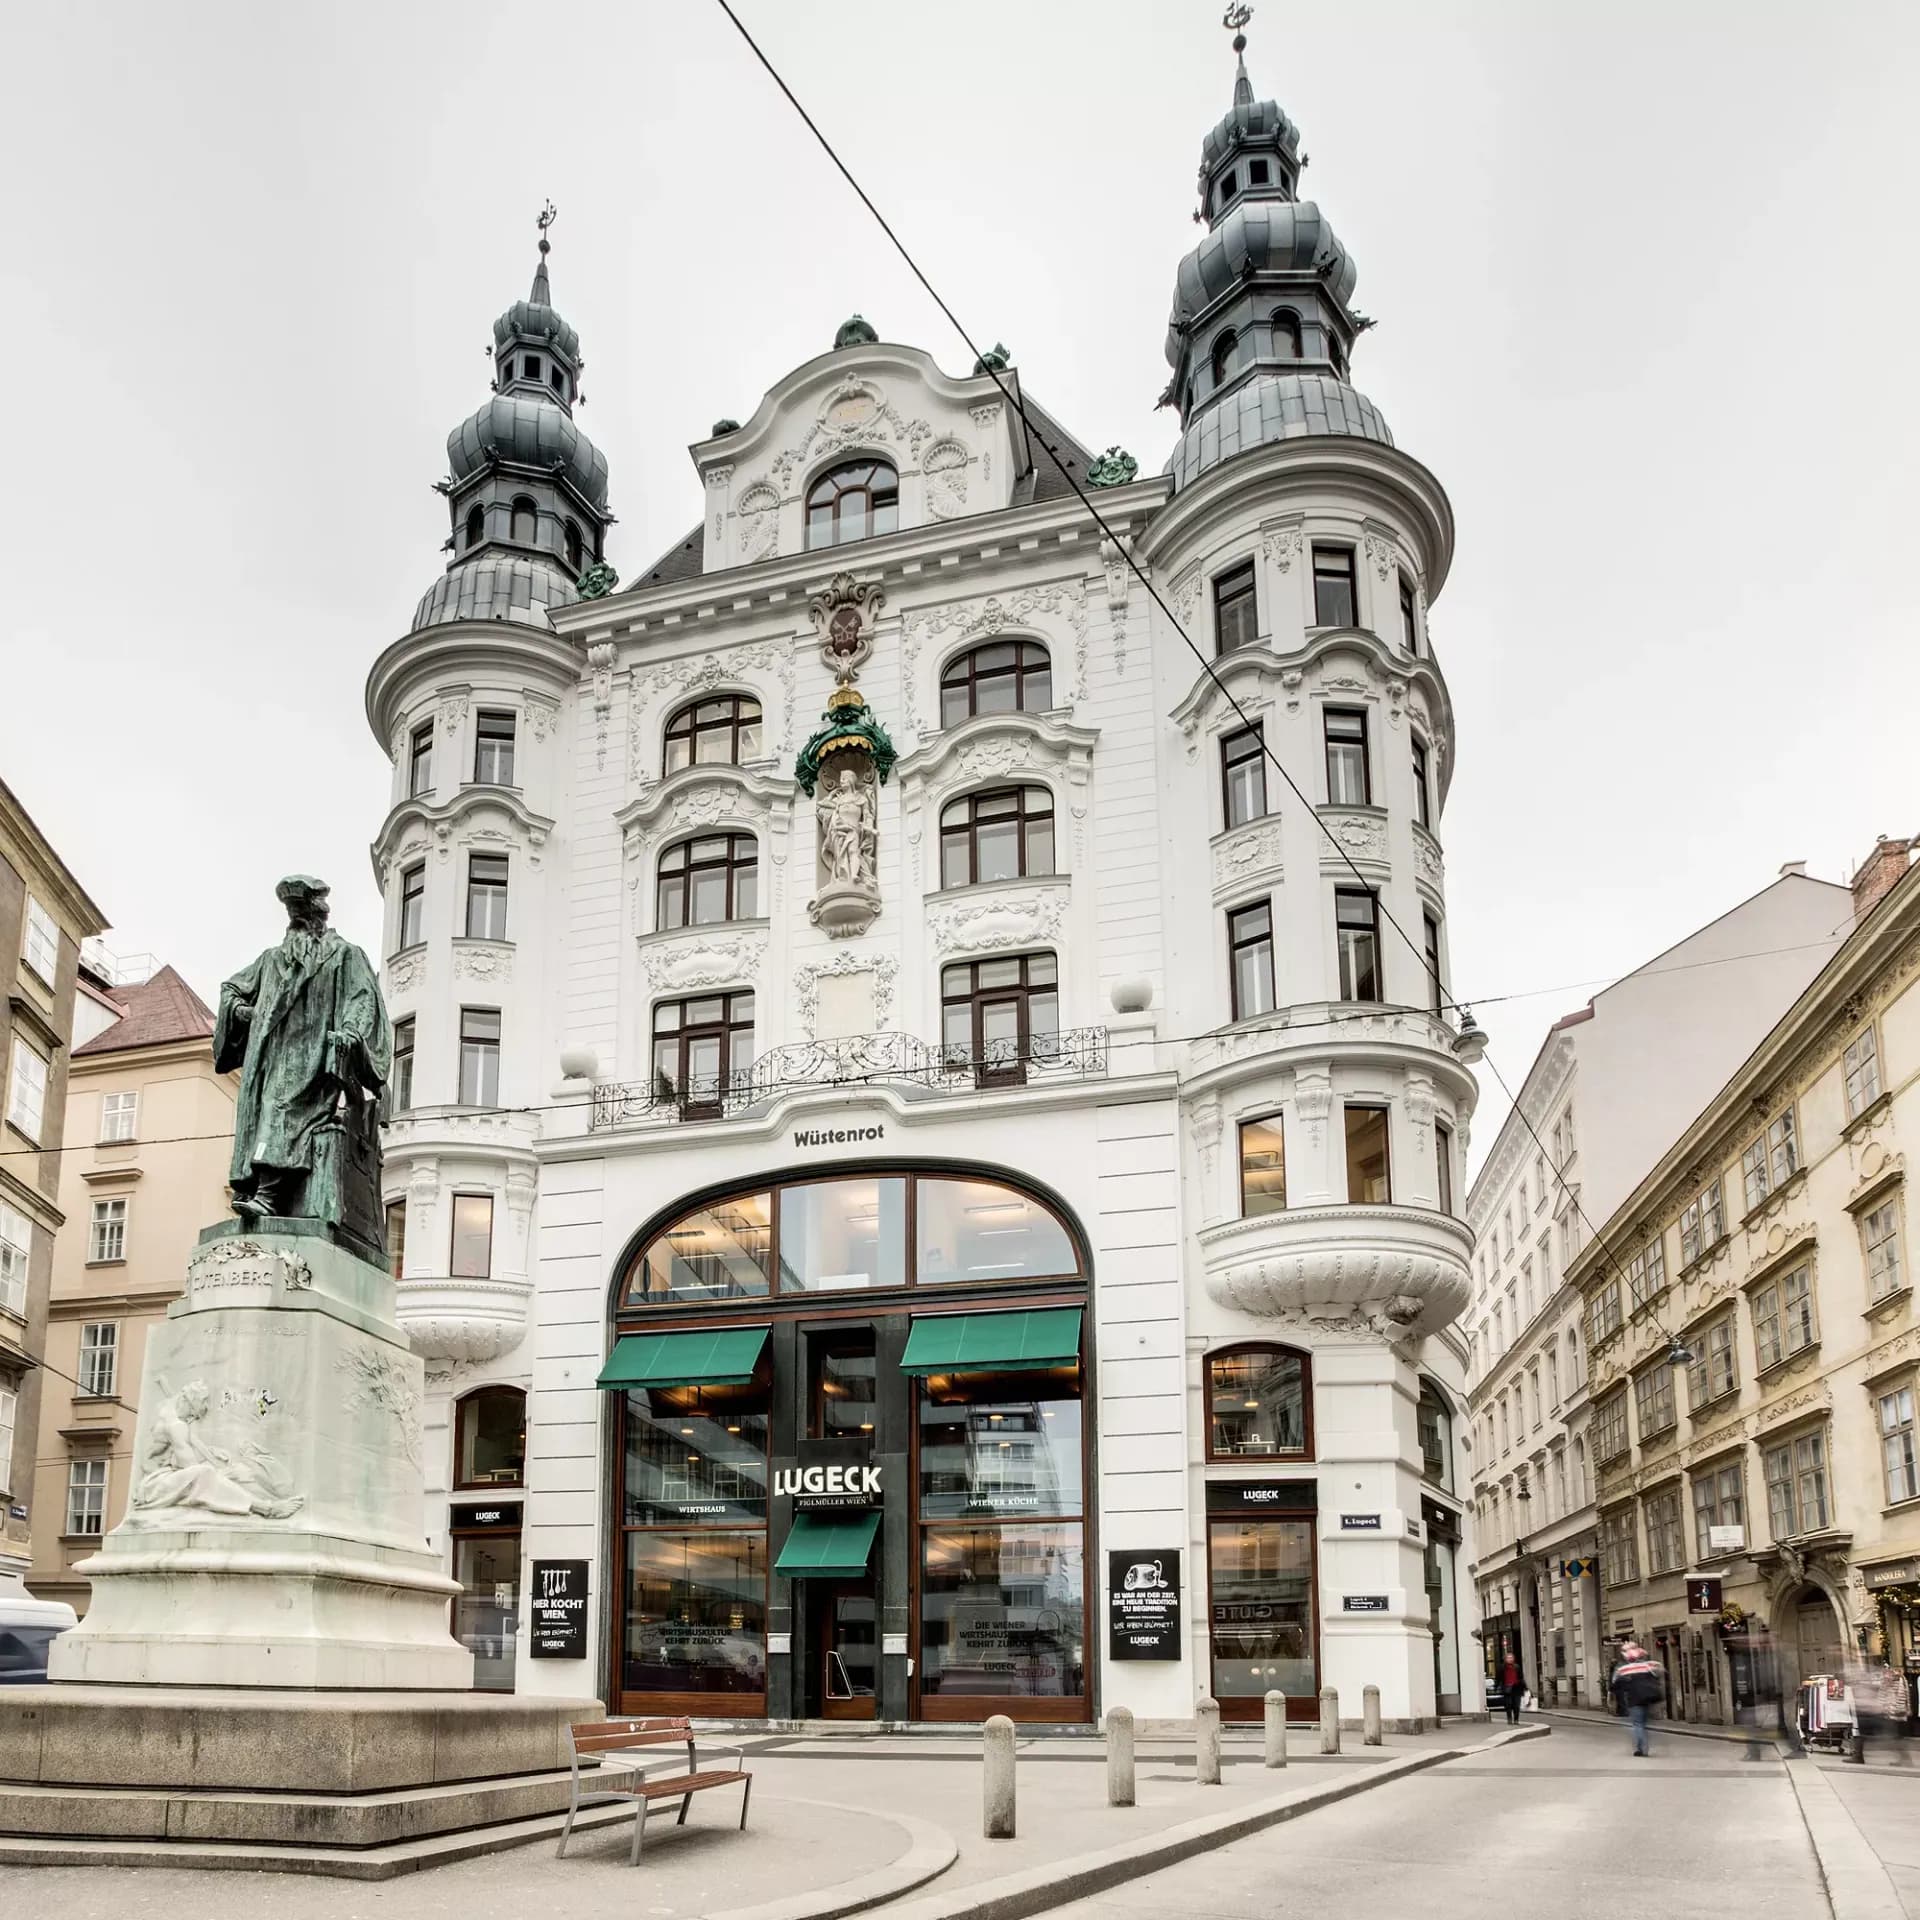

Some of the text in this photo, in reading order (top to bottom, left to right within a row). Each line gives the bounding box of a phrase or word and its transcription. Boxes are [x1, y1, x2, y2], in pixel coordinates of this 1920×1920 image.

[794, 1124, 884, 1147] Wüstenrot
[774, 1466, 882, 1496] LUGECK
[1243, 1490, 1279, 1499] LUGECK
[799, 1497, 867, 1506] FIGLMÜLLER WIEN
[678, 1505, 726, 1513] WIRTSHAUS
[475, 1511, 501, 1520] LUGECK
[550, 1599, 584, 1608] KOCHT
[975, 1620, 1025, 1629] DIE WIENER
[966, 1639, 994, 1648] KEHRT
[1130, 1636, 1160, 1645] LUGECK
[983, 1662, 1017, 1672] LUGECK
